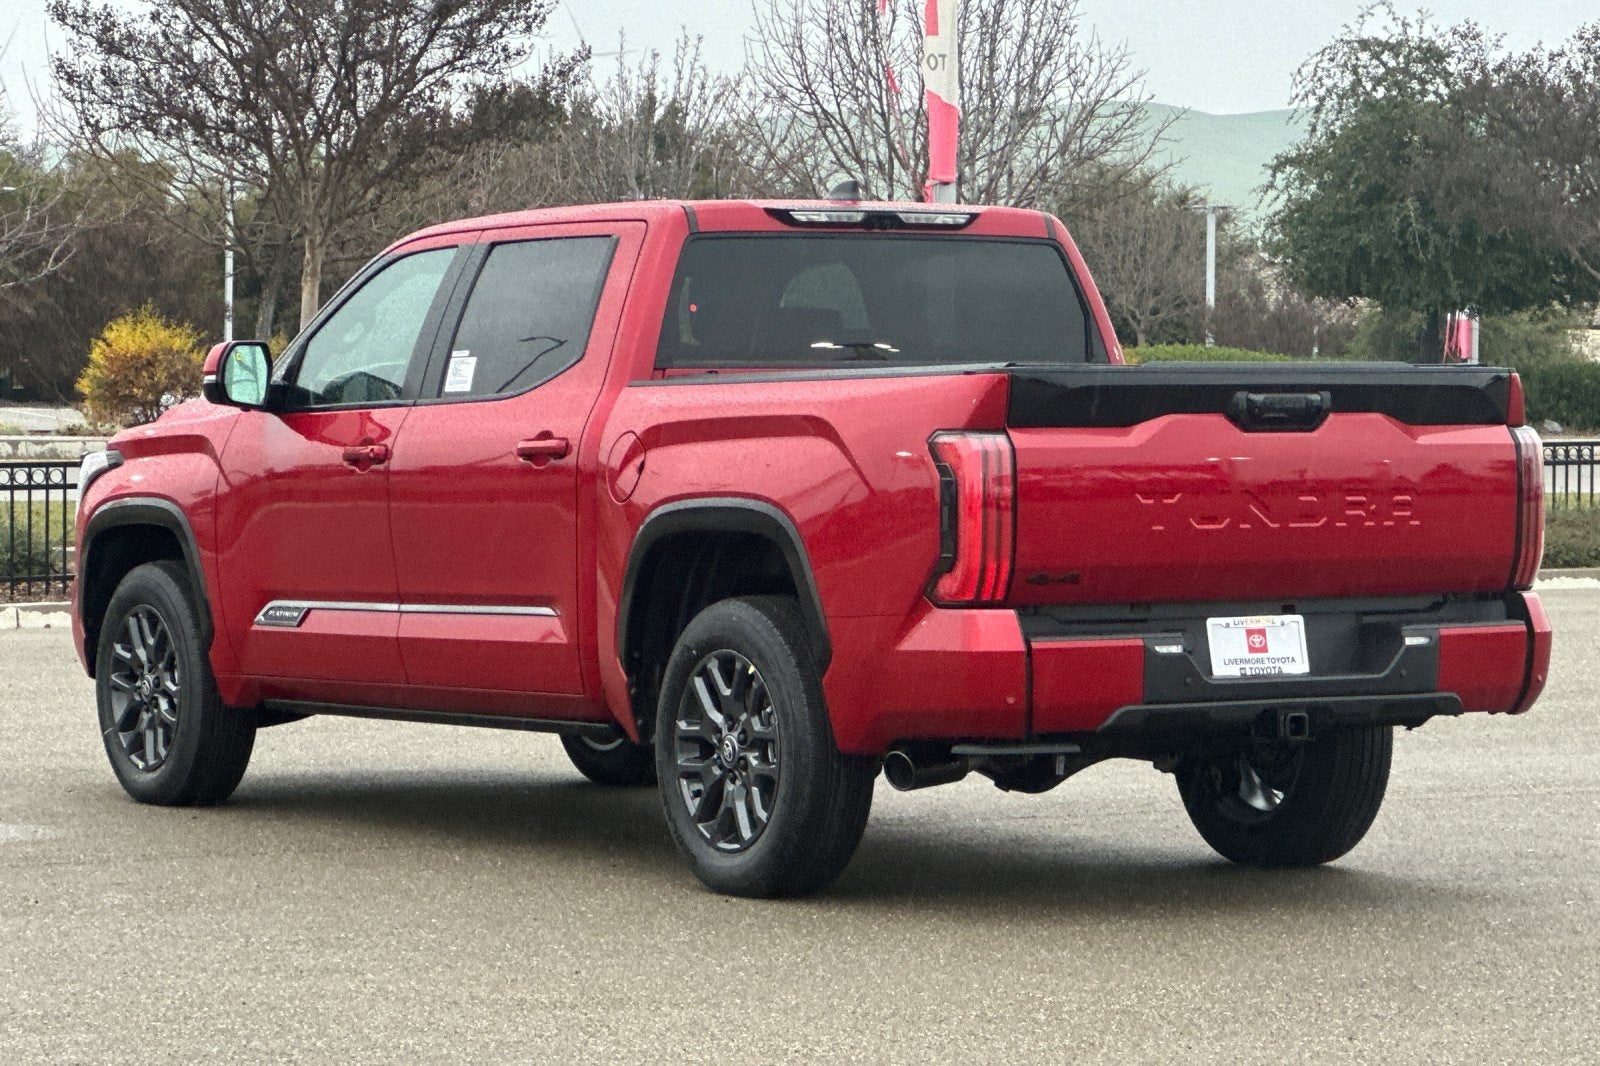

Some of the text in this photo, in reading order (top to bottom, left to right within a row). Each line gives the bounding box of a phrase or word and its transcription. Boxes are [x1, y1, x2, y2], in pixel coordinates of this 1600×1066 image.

[1135, 491, 1421, 530] TUNDRA
[1223, 656, 1296, 666] LIVERMORE TOYOTA
[1249, 666, 1282, 675] TOYOTA
